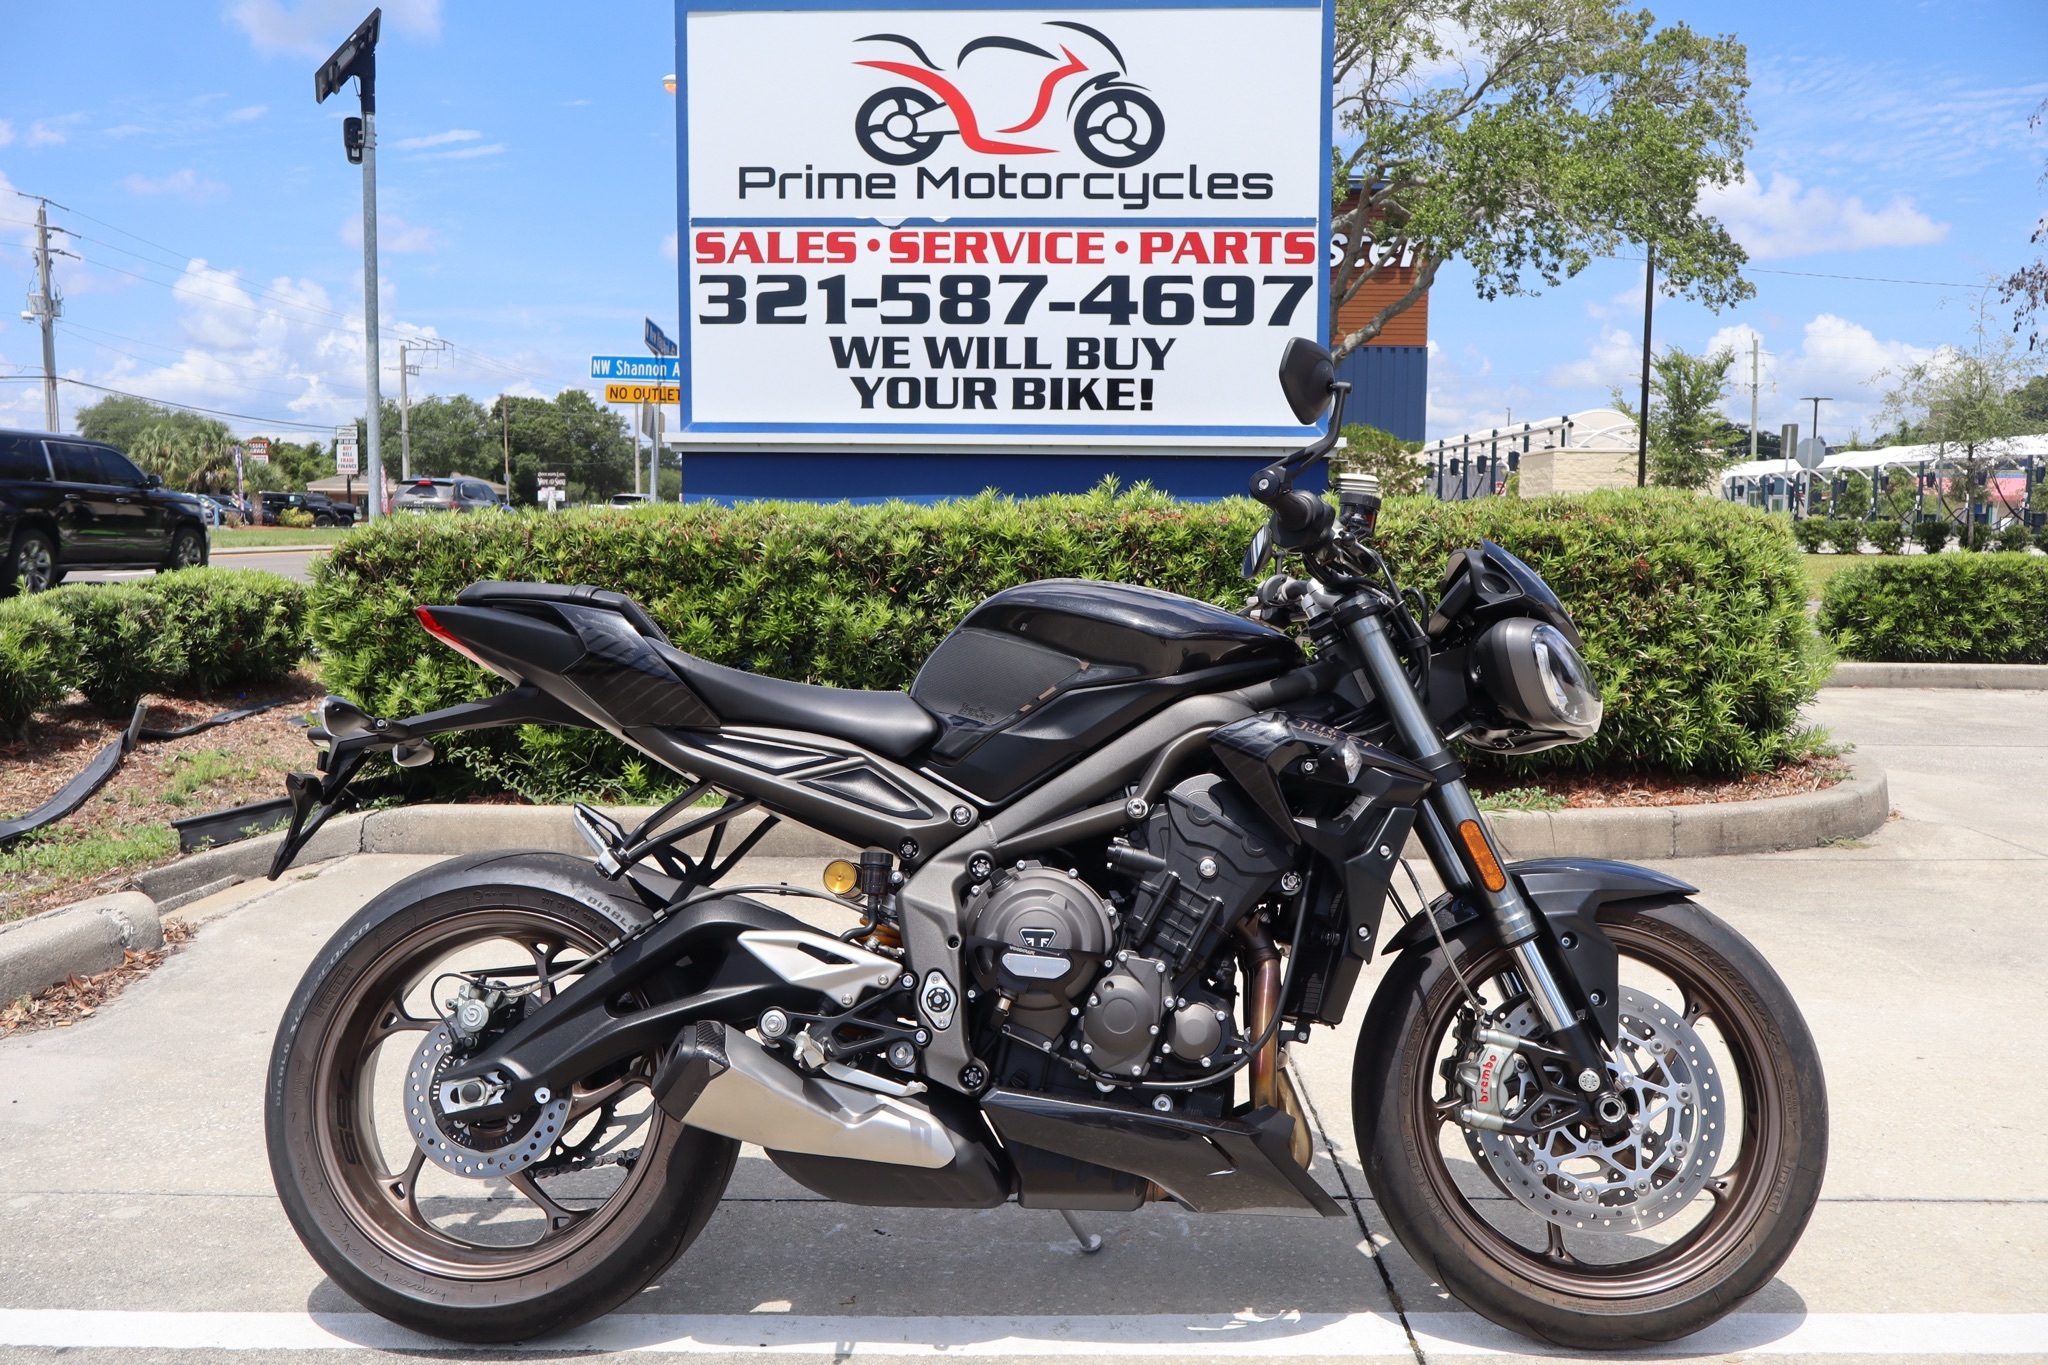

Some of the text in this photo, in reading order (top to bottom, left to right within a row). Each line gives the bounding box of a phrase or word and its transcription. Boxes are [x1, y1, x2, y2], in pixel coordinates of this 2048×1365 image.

[739, 164, 1273, 209] Prime Motorcycles
[696, 232, 1315, 264] SALES SERVICE PARTS
[699, 275, 1313, 326] 321-587-4697
[593, 360, 611, 375] NW
[616, 360, 667, 376] Shannon
[829, 337, 1176, 370] WE WILL BUY
[609, 387, 628, 400] NO
[850, 377, 1153, 410] YOUR BIKE!
[275, 1041, 290, 1107] DIABLO
[1478, 1054, 1497, 1103] brembo
